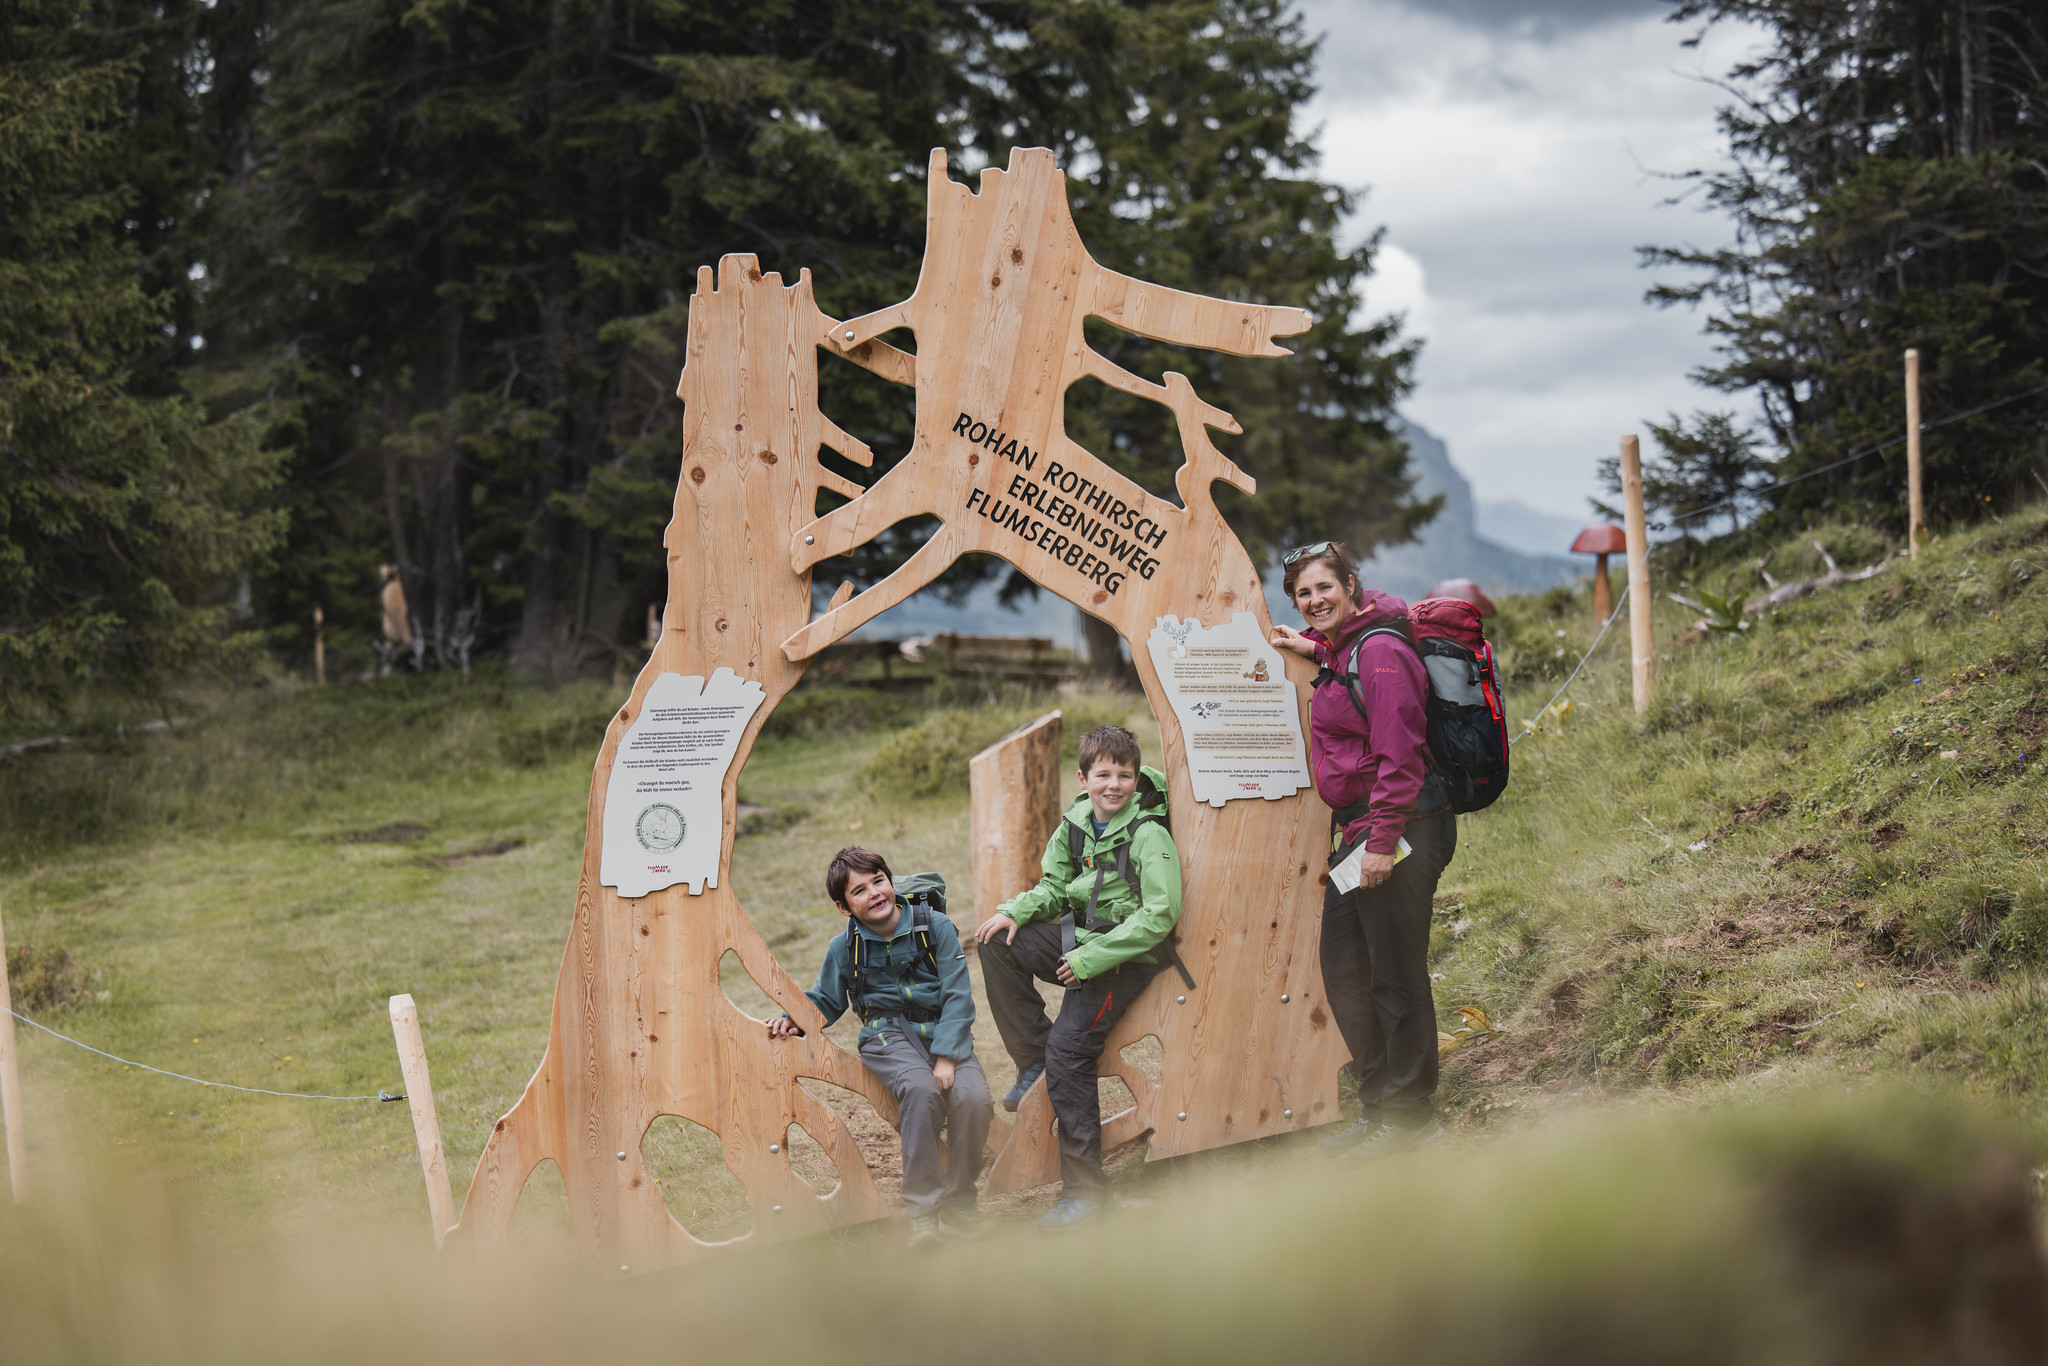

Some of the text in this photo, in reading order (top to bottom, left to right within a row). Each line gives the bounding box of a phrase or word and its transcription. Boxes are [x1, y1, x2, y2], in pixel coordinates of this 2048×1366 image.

[952, 412, 1168, 550] ROHAN ROTHIRSCH
[1008, 474, 1161, 580] ERLEBNISWEG
[966, 488, 1126, 596] FLUMSERBERG
